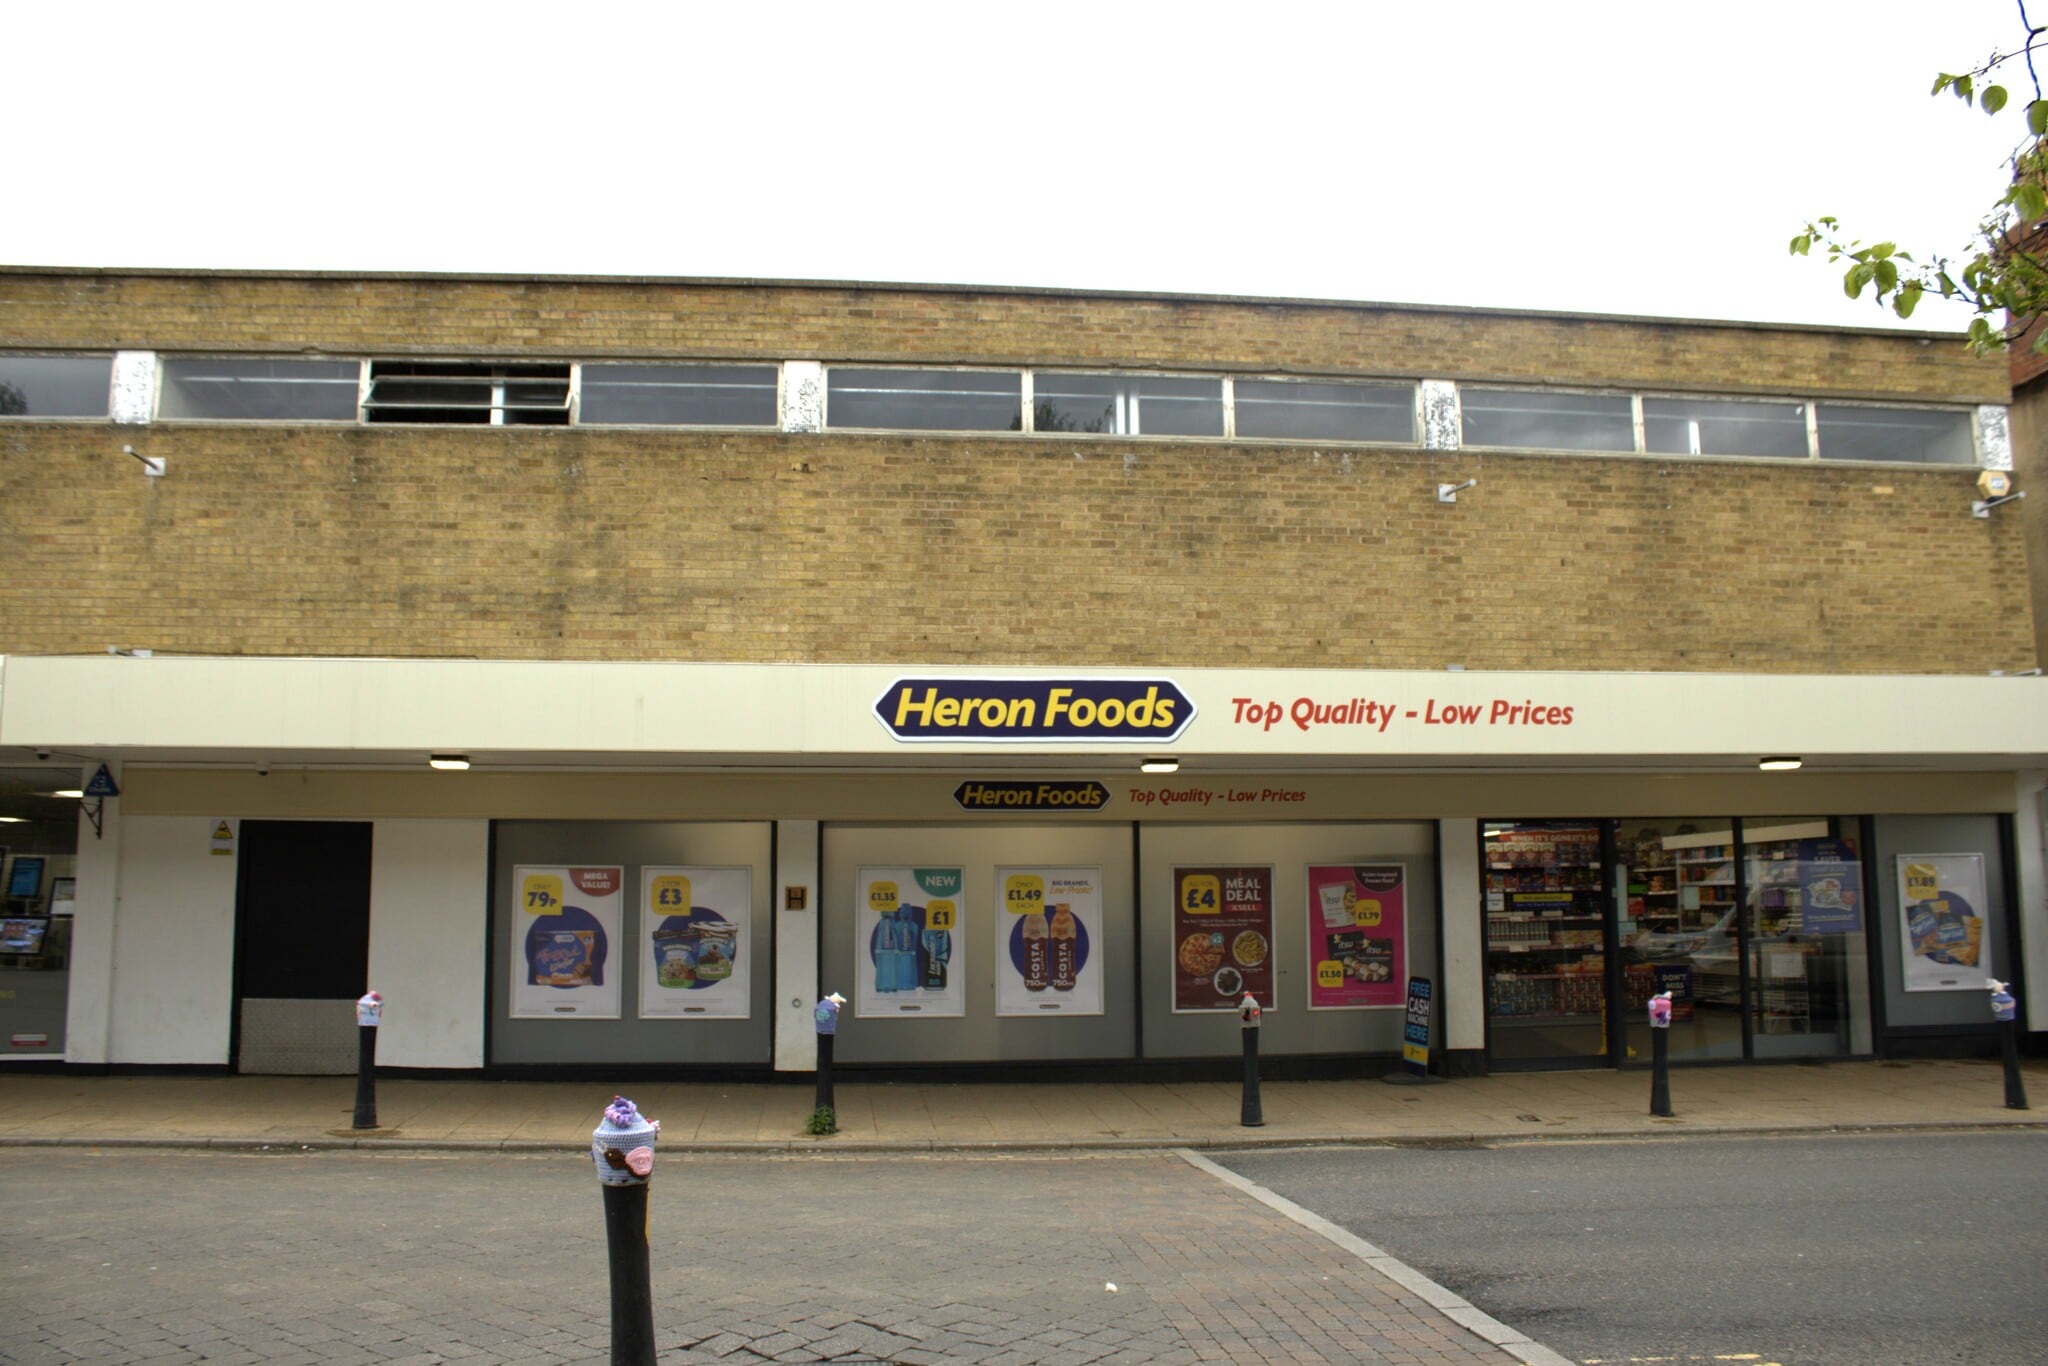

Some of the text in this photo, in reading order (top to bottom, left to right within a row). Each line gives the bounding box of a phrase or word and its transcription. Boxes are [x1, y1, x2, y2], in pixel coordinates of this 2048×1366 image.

[894, 686, 1176, 728] Heron Foods
[1231, 697, 1574, 733] Top Quality - Low Prices
[962, 784, 1102, 805] Heron Foods
[1129, 788, 1156, 806] Top
[1159, 788, 1214, 806] Quality
[1227, 788, 1257, 802] Low
[1261, 788, 1306, 802] Prices
[583, 872, 609, 880] MEGA
[925, 875, 956, 887] NEW
[1226, 878, 1261, 889] MEAL
[580, 881, 611, 889] VALUE!
[659, 888, 682, 905] £3
[787, 887, 805, 909] H
[871, 892, 896, 902] £1.35
[1008, 889, 1042, 901] £1.49
[1186, 889, 1215, 908] £4
[1226, 889, 1261, 901] DEAL
[933, 911, 949, 925] £1
[1338, 941, 1354, 949] itsu
[1031, 942, 1040, 980] COSTA
[1058, 942, 1067, 980] COSTA
[1409, 981, 1431, 998] FREE
[1408, 996, 1430, 1016] CASH
[1406, 1023, 1428, 1041] HERE
